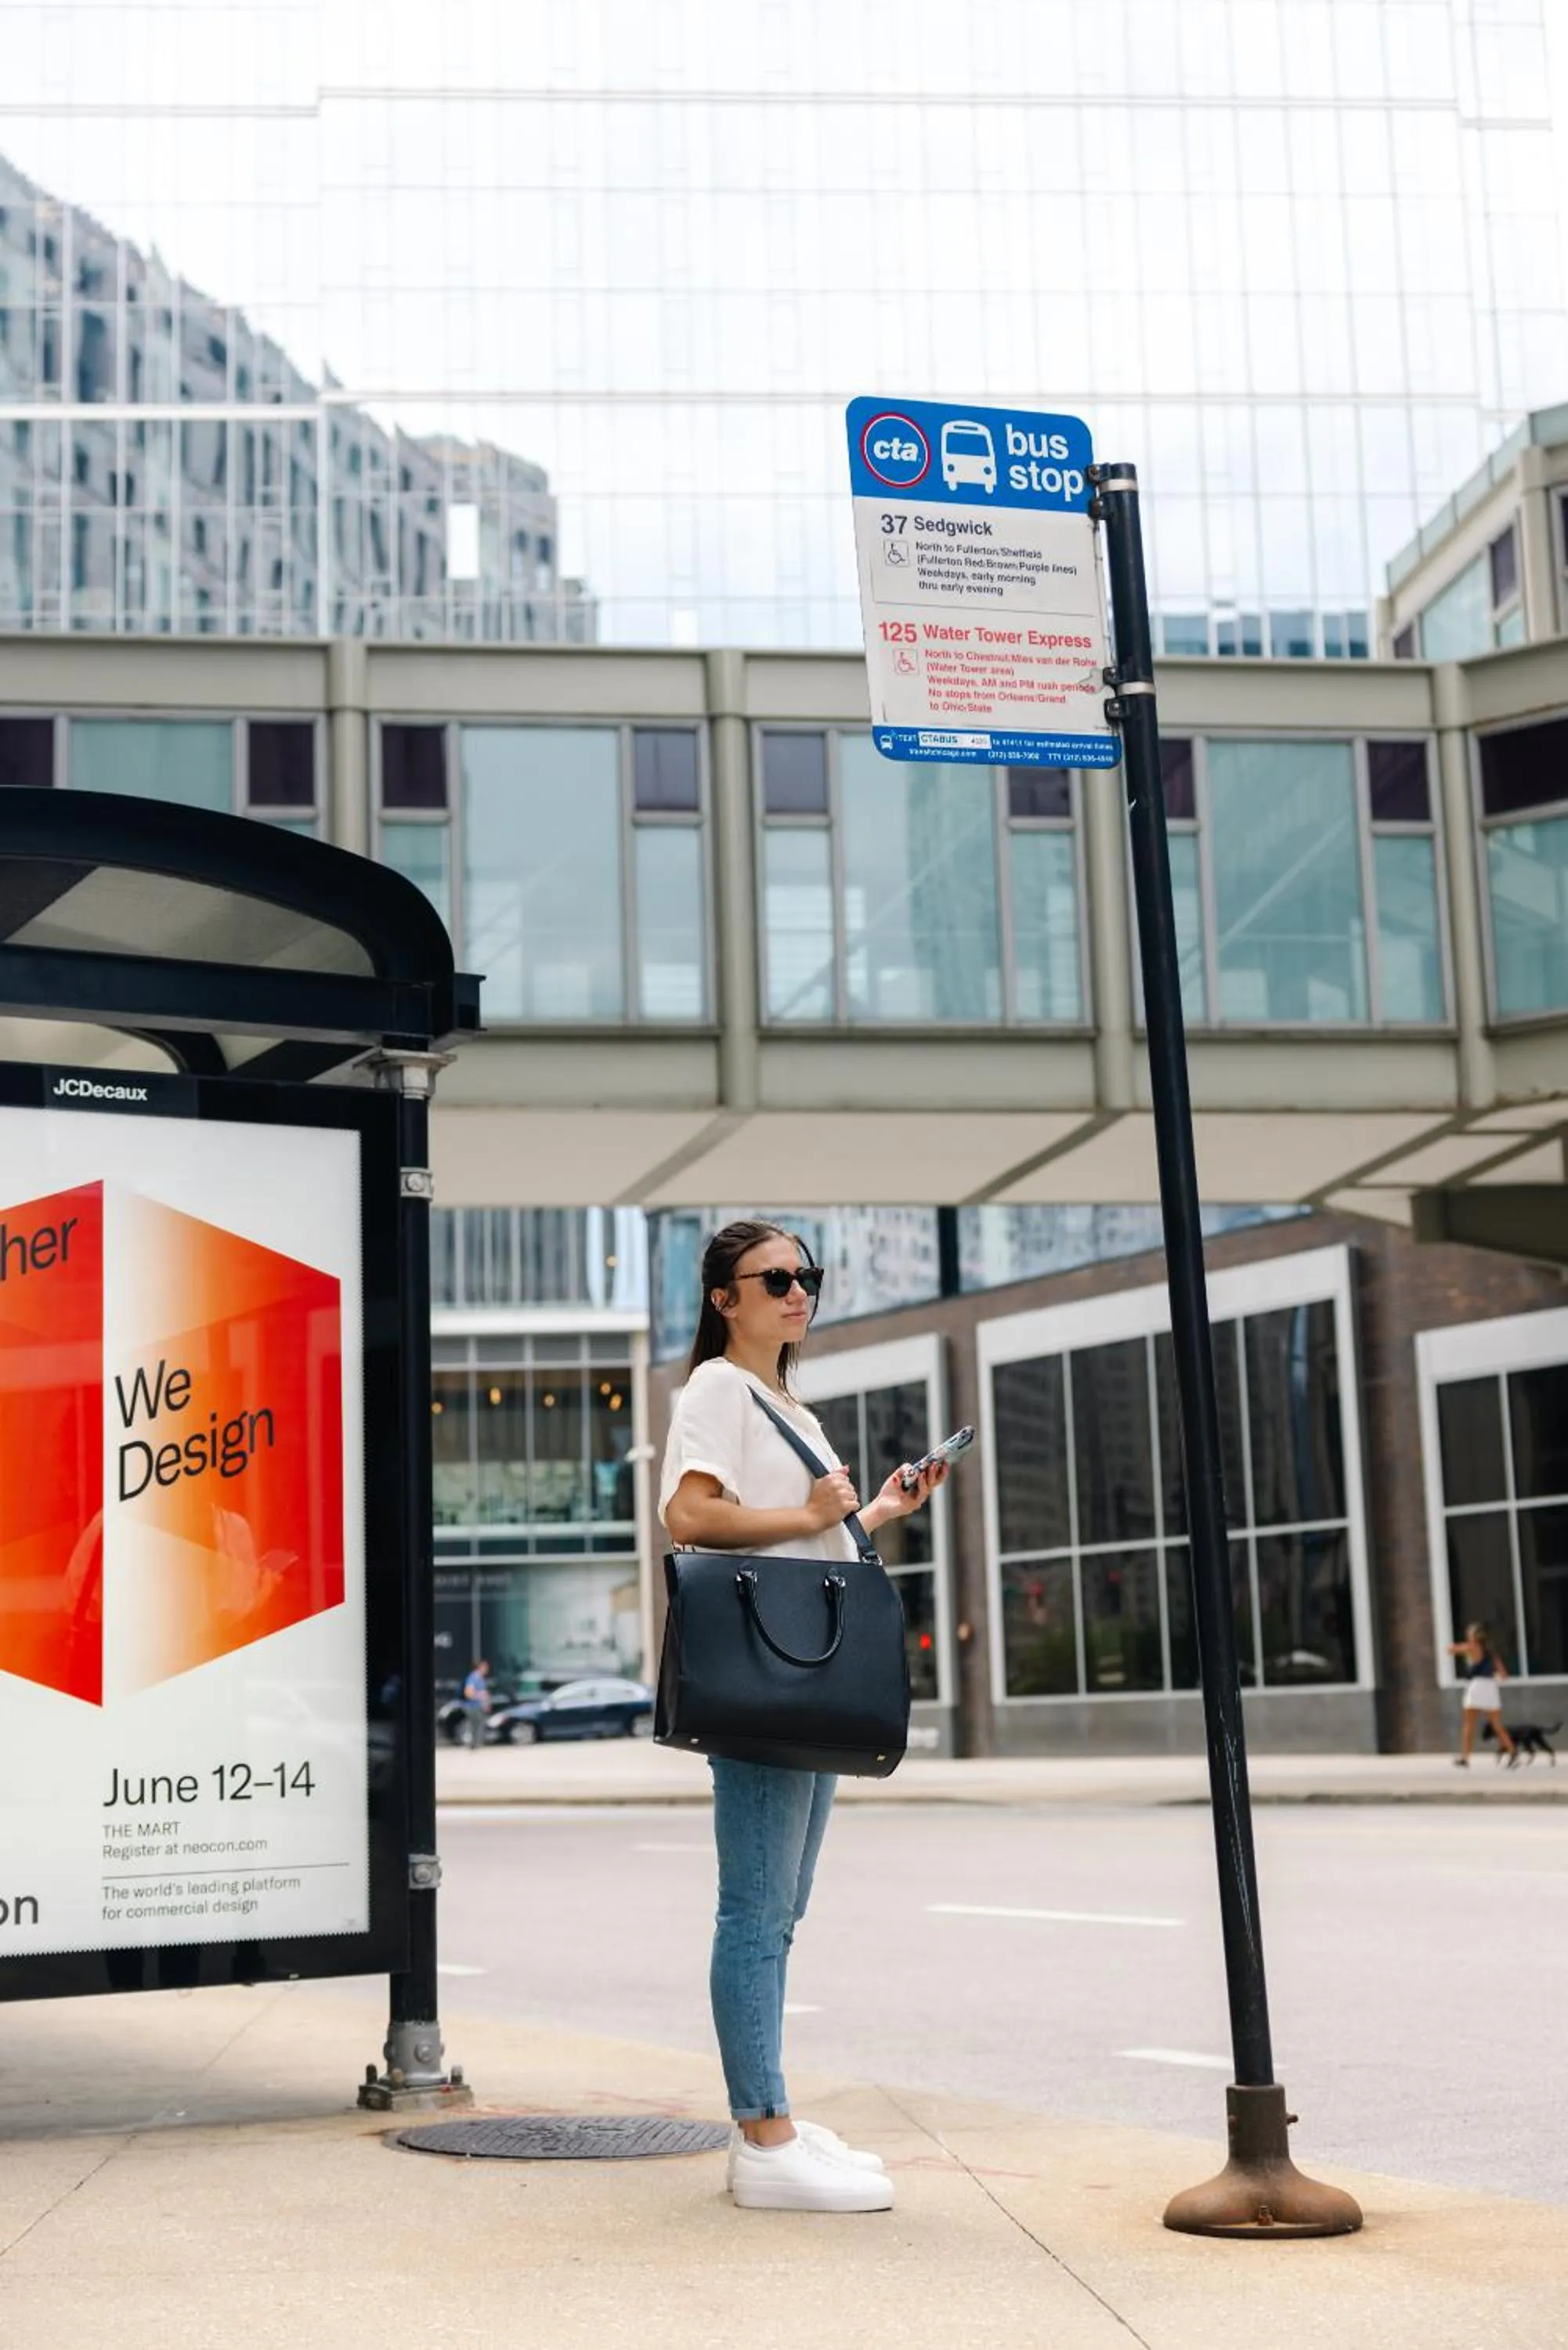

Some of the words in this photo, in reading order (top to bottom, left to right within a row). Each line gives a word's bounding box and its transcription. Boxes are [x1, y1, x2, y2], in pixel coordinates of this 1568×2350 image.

[873, 437, 919, 461] cta
[1006, 423, 1069, 460] bus
[1009, 461, 1084, 502] stop
[880, 514, 908, 534] 37
[914, 516, 993, 537] Sedgwick
[916, 541, 941, 552] North
[944, 544, 954, 553] to
[917, 555, 963, 567] (Fullerton
[1052, 564, 1077, 576] lines)
[918, 567, 969, 581] Weekdays,
[971, 571, 994, 584] early
[997, 573, 1036, 586] morning
[919, 580, 938, 591] thru
[941, 582, 964, 594] early
[966, 585, 1003, 597] evening
[879, 621, 917, 643] 125
[923, 624, 971, 642] Water
[975, 627, 1022, 644] Tower
[1028, 631, 1092, 649] Express
[925, 649, 952, 660] North
[955, 651, 964, 660] to
[1035, 656, 1053, 665] van
[1055, 656, 1070, 666] der
[1073, 657, 1097, 667] Rohe
[927, 662, 957, 673] (Water
[961, 664, 988, 674] Tower
[991, 667, 1014, 677] area)
[927, 675, 978, 689] Weekdays,
[981, 678, 997, 687] AM
[999, 678, 1017, 689] and
[1020, 679, 1035, 689] PM
[1038, 681, 1058, 691] rush
[1060, 682, 1096, 693] periods
[928, 688, 942, 697] No
[945, 689, 971, 700] stops
[974, 690, 995, 700] from
[930, 702, 939, 710] to
[920, 734, 958, 743] CTABUS
[53, 1079, 148, 1101] JCDecaux
[0, 1217, 78, 1282] her
[114, 1359, 191, 1429] We
[119, 1407, 275, 1502] Design
[103, 1768, 199, 1807] June
[103, 1824, 132, 1838] THE
[137, 1821, 182, 1838] MART
[103, 1842, 161, 1860] Register
[164, 1842, 179, 1856] at
[182, 1838, 268, 1855] neocon.com
[103, 1885, 128, 1900] The
[132, 1882, 184, 1898] world's
[187, 1878, 239, 1896] leading
[242, 1875, 301, 1895] platform
[102, 1905, 122, 1921] for
[126, 1900, 209, 1919] commercial
[211, 1897, 259, 1916] design
